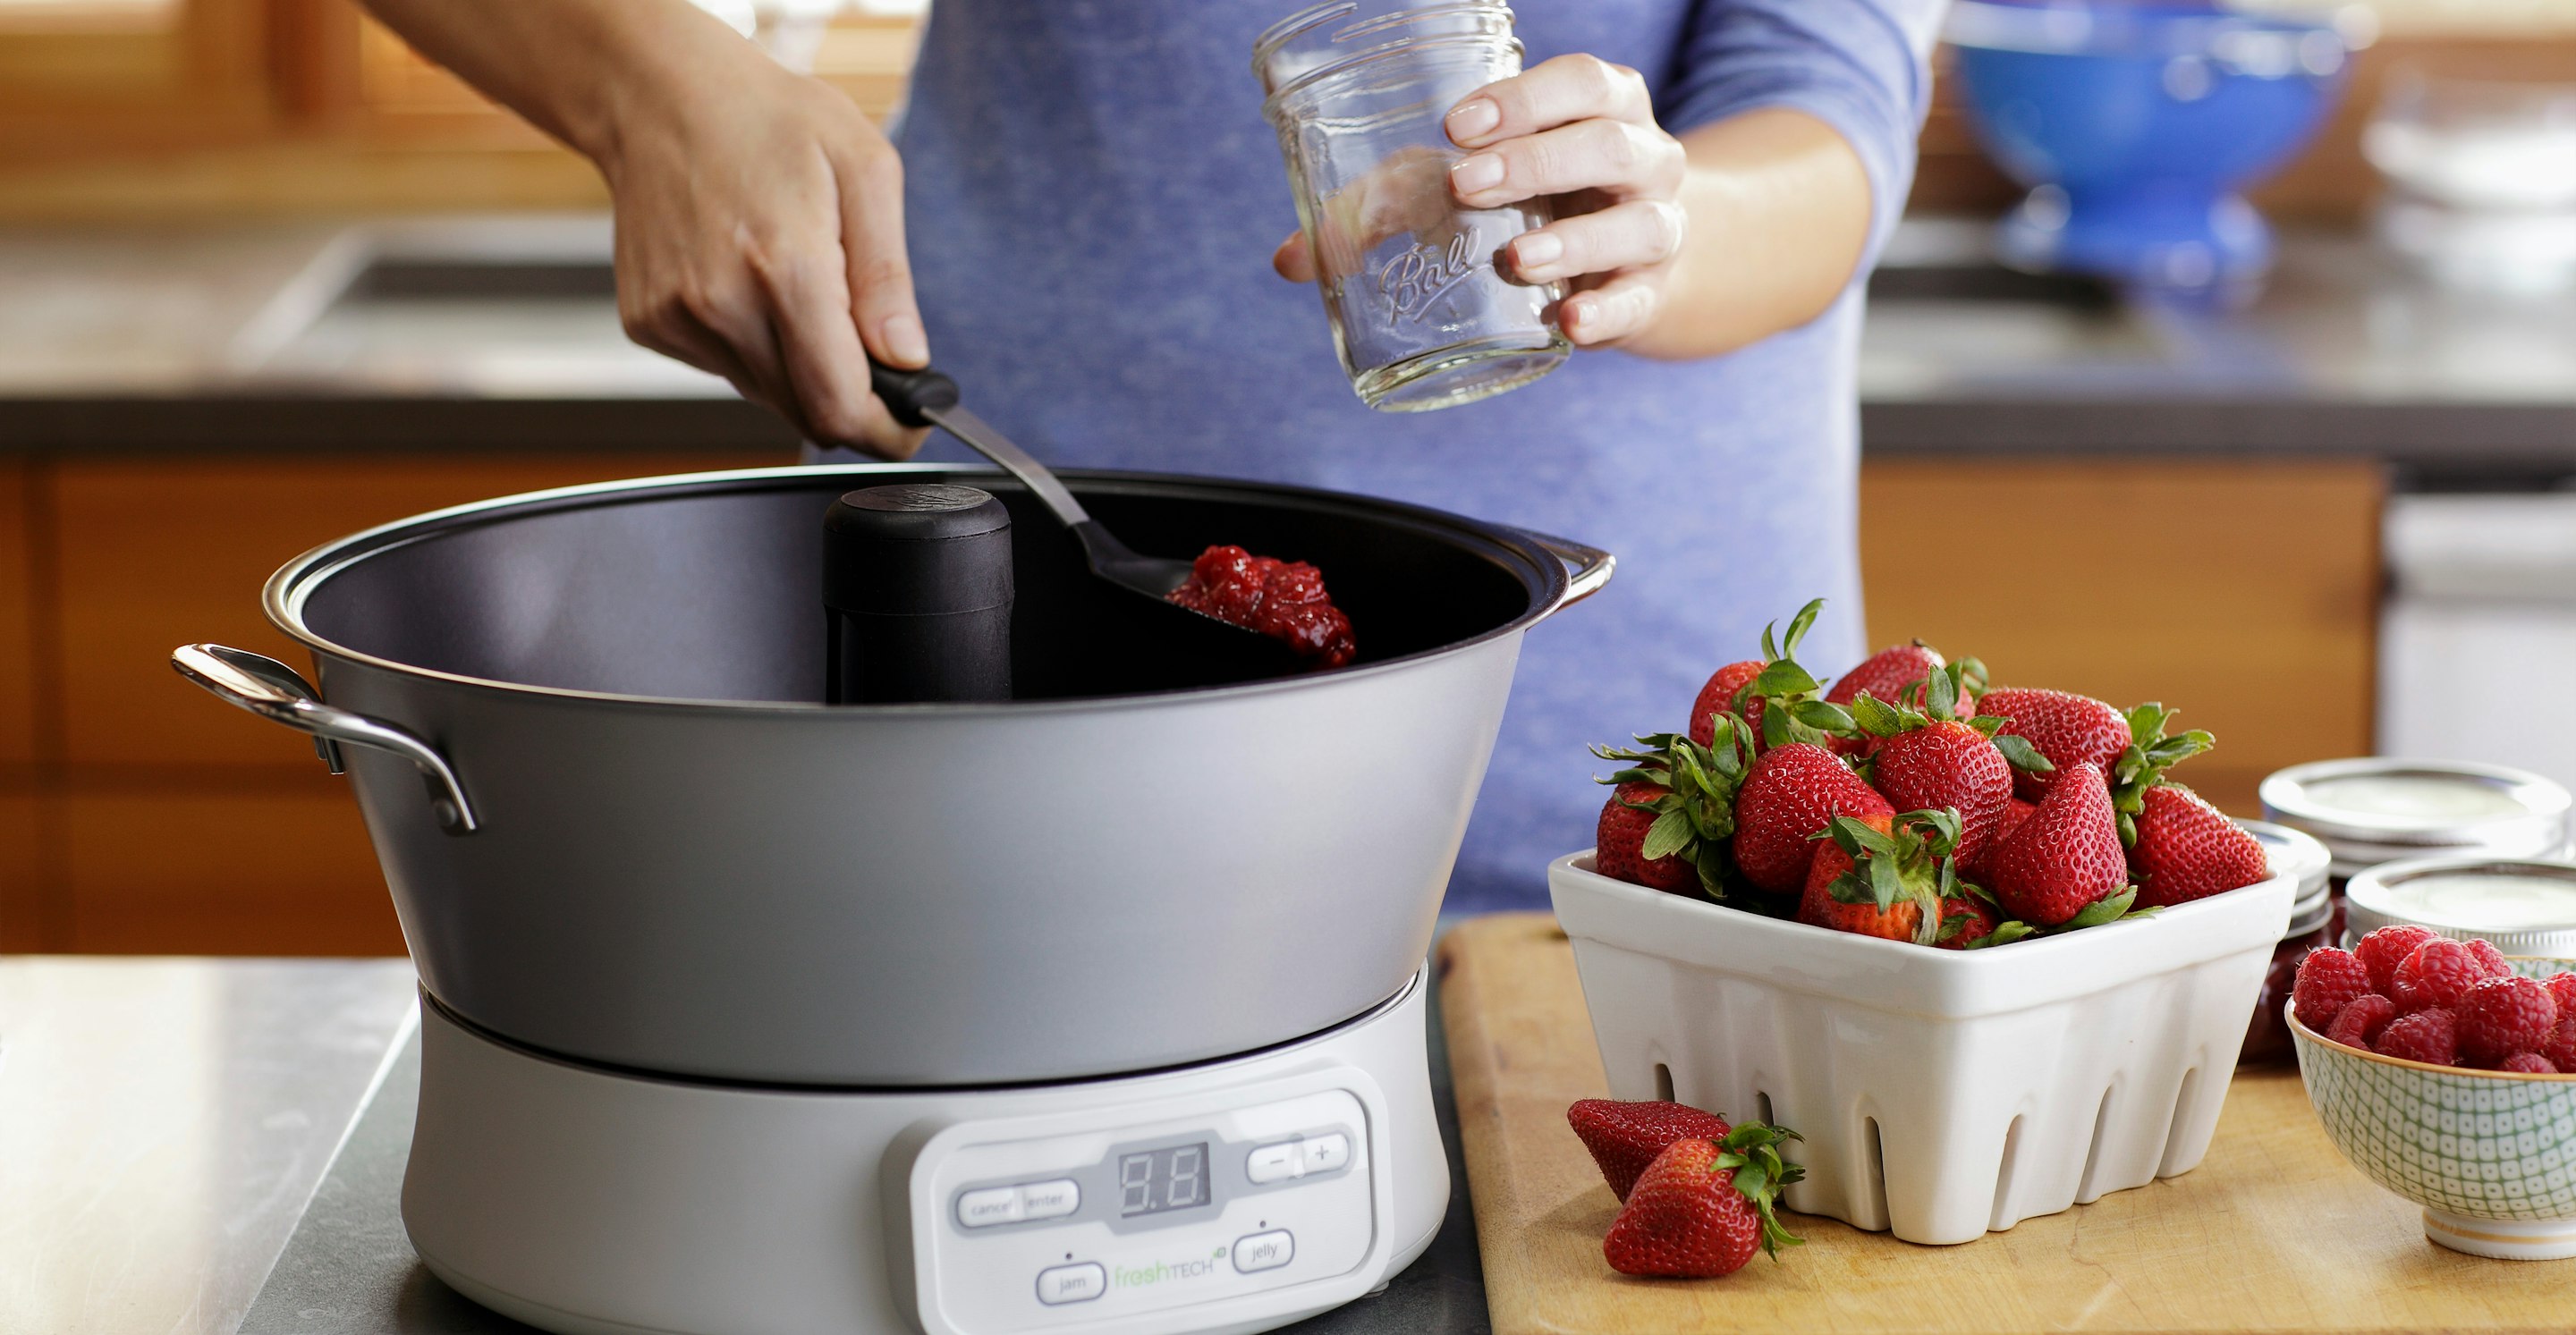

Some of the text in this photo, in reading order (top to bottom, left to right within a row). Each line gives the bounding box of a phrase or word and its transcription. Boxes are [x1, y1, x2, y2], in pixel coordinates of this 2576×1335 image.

[1379, 225, 1481, 325] Ball
[1027, 1194, 1063, 1207] enter
[1250, 1243, 1278, 1263] jelly
[1114, 1259, 1214, 1289] freshTECH
[1059, 1276, 1087, 1295] jam
